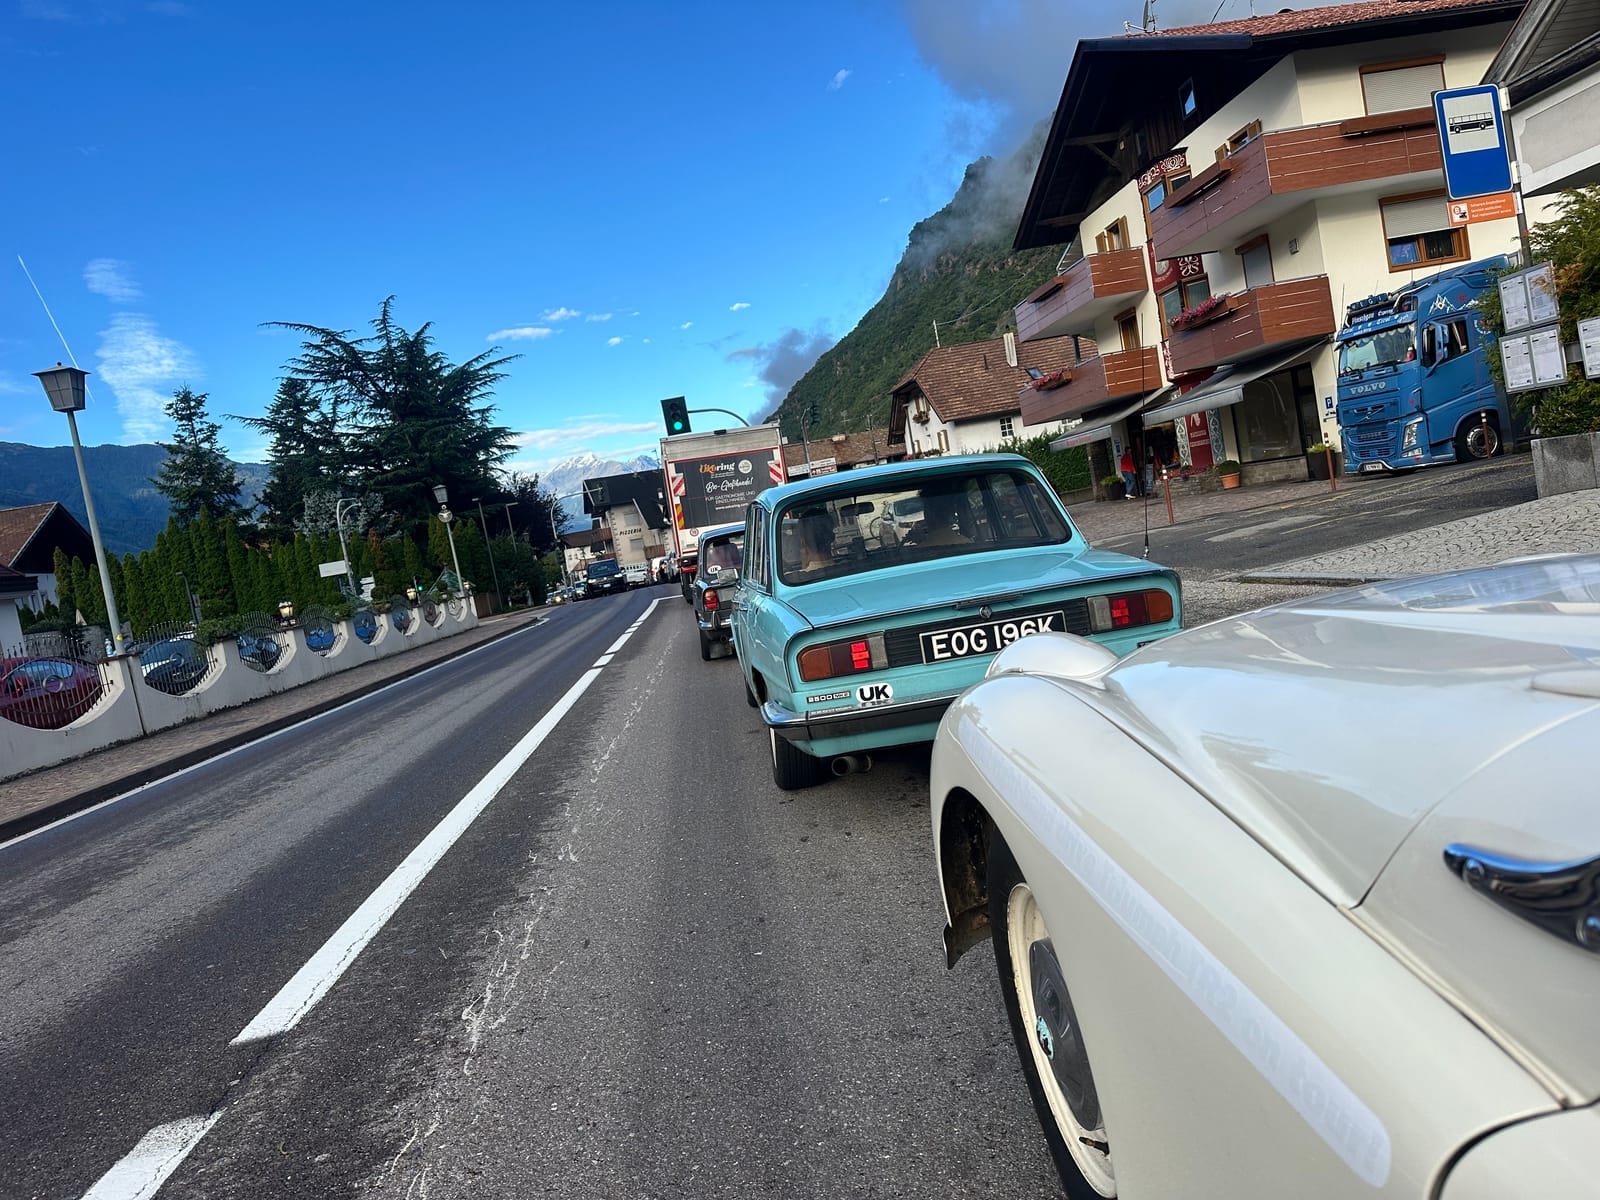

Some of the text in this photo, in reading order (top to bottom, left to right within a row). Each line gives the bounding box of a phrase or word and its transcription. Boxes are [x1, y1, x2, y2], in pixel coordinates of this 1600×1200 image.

[1350, 381, 1386, 394] VOLVO
[619, 528, 642, 536] PIZZERIA
[930, 616, 1054, 660] EOG 196K
[859, 684, 890, 701] UK
